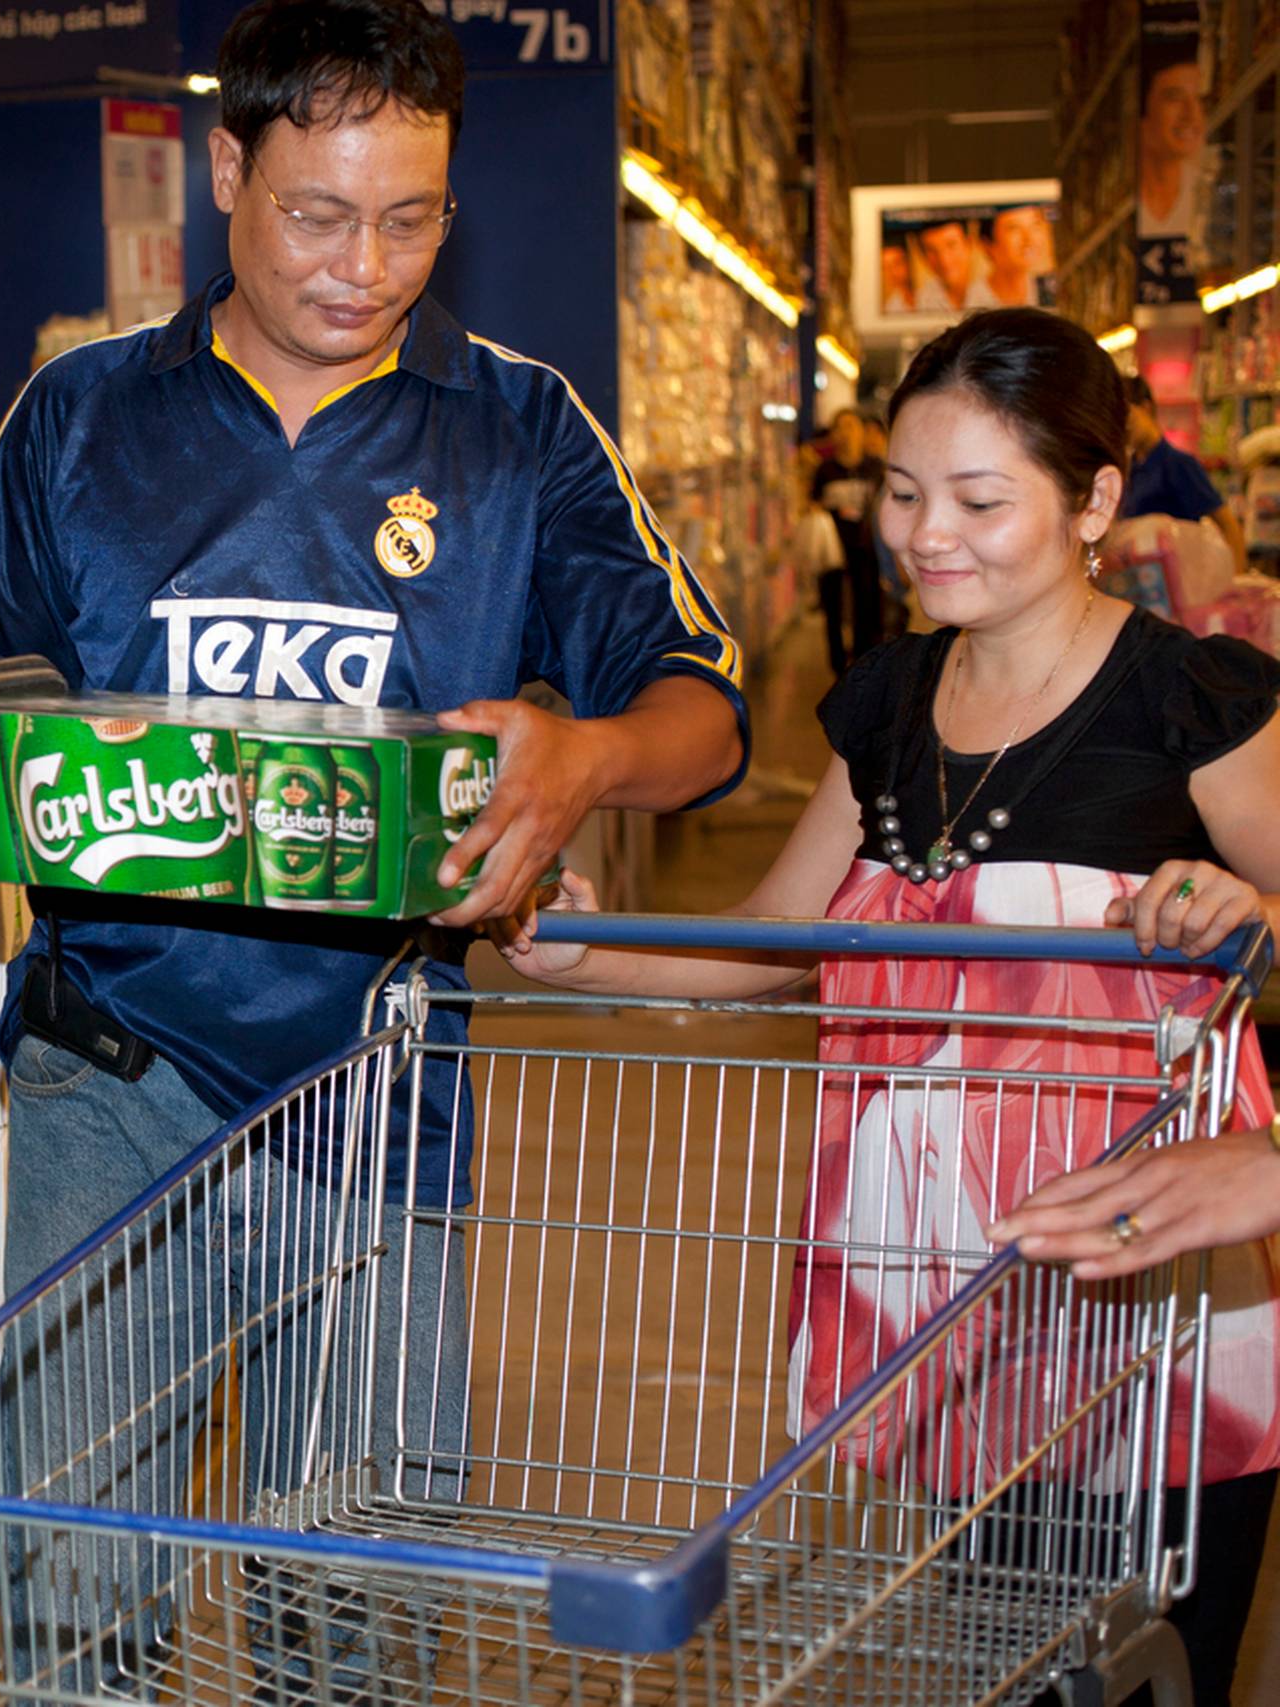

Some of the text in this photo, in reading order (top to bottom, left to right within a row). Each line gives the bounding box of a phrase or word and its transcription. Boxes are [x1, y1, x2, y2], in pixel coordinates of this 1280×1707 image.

[510, 9, 590, 62] 7b
[150, 598, 399, 708] Teka
[21, 732, 244, 863] Carlsberg
[255, 799, 333, 837] Carlsberg
[202, 881, 234, 897] BEER
